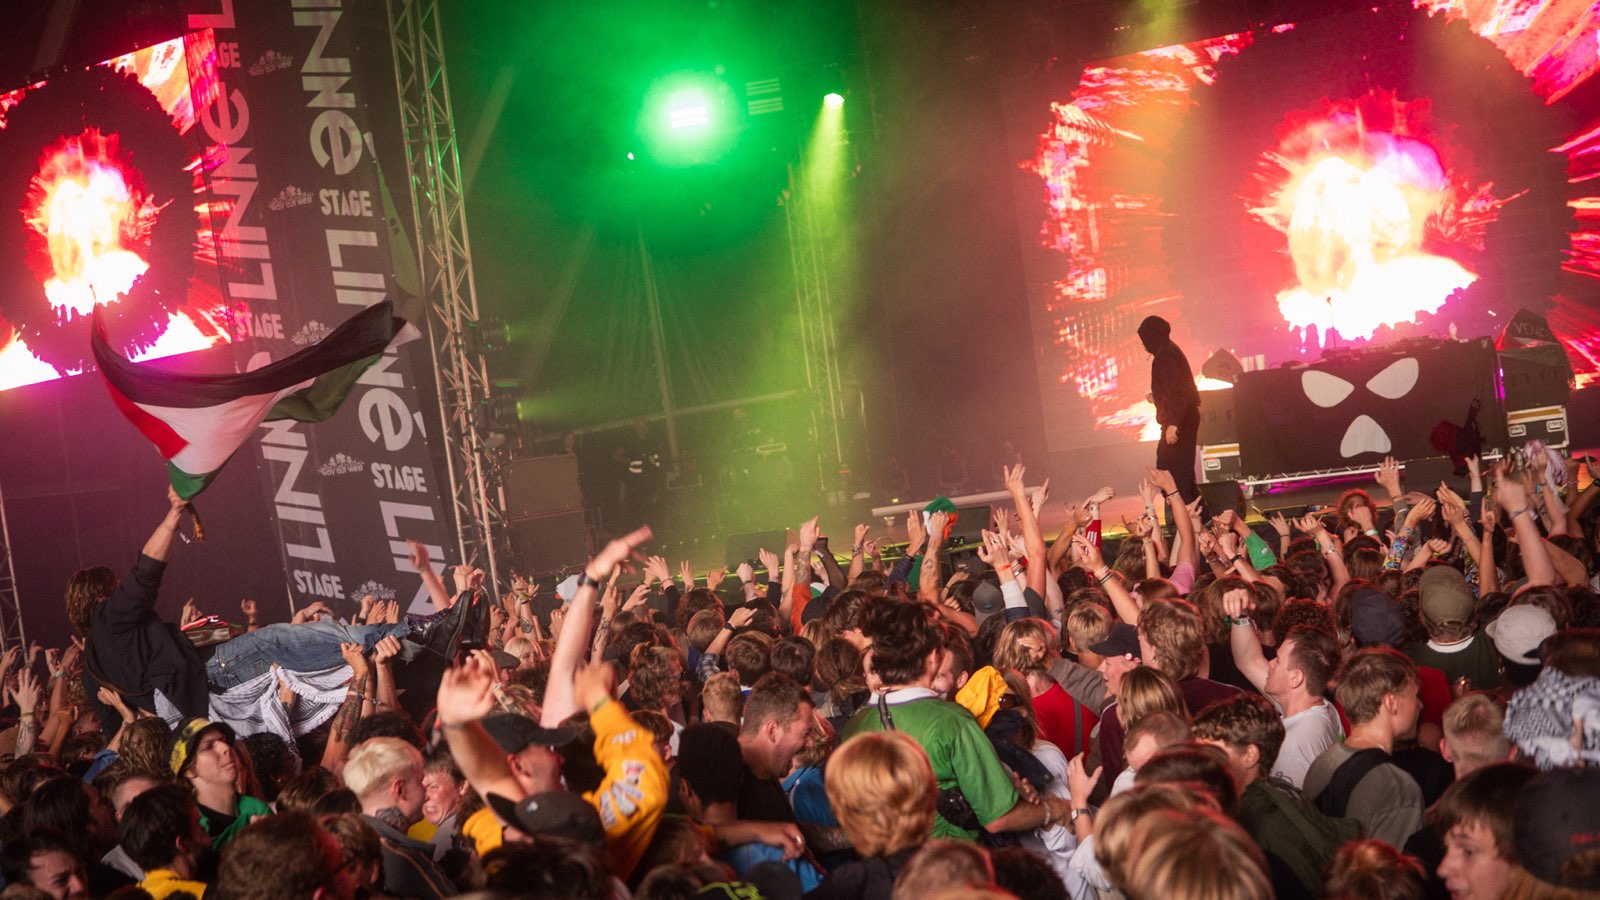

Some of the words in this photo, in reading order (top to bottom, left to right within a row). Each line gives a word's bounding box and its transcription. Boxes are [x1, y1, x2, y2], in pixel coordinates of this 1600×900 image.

[319, 189, 373, 217] STAGE
[234, 311, 285, 340] STAGE
[370, 462, 427, 492] STAGE
[294, 570, 345, 599] STAGE
